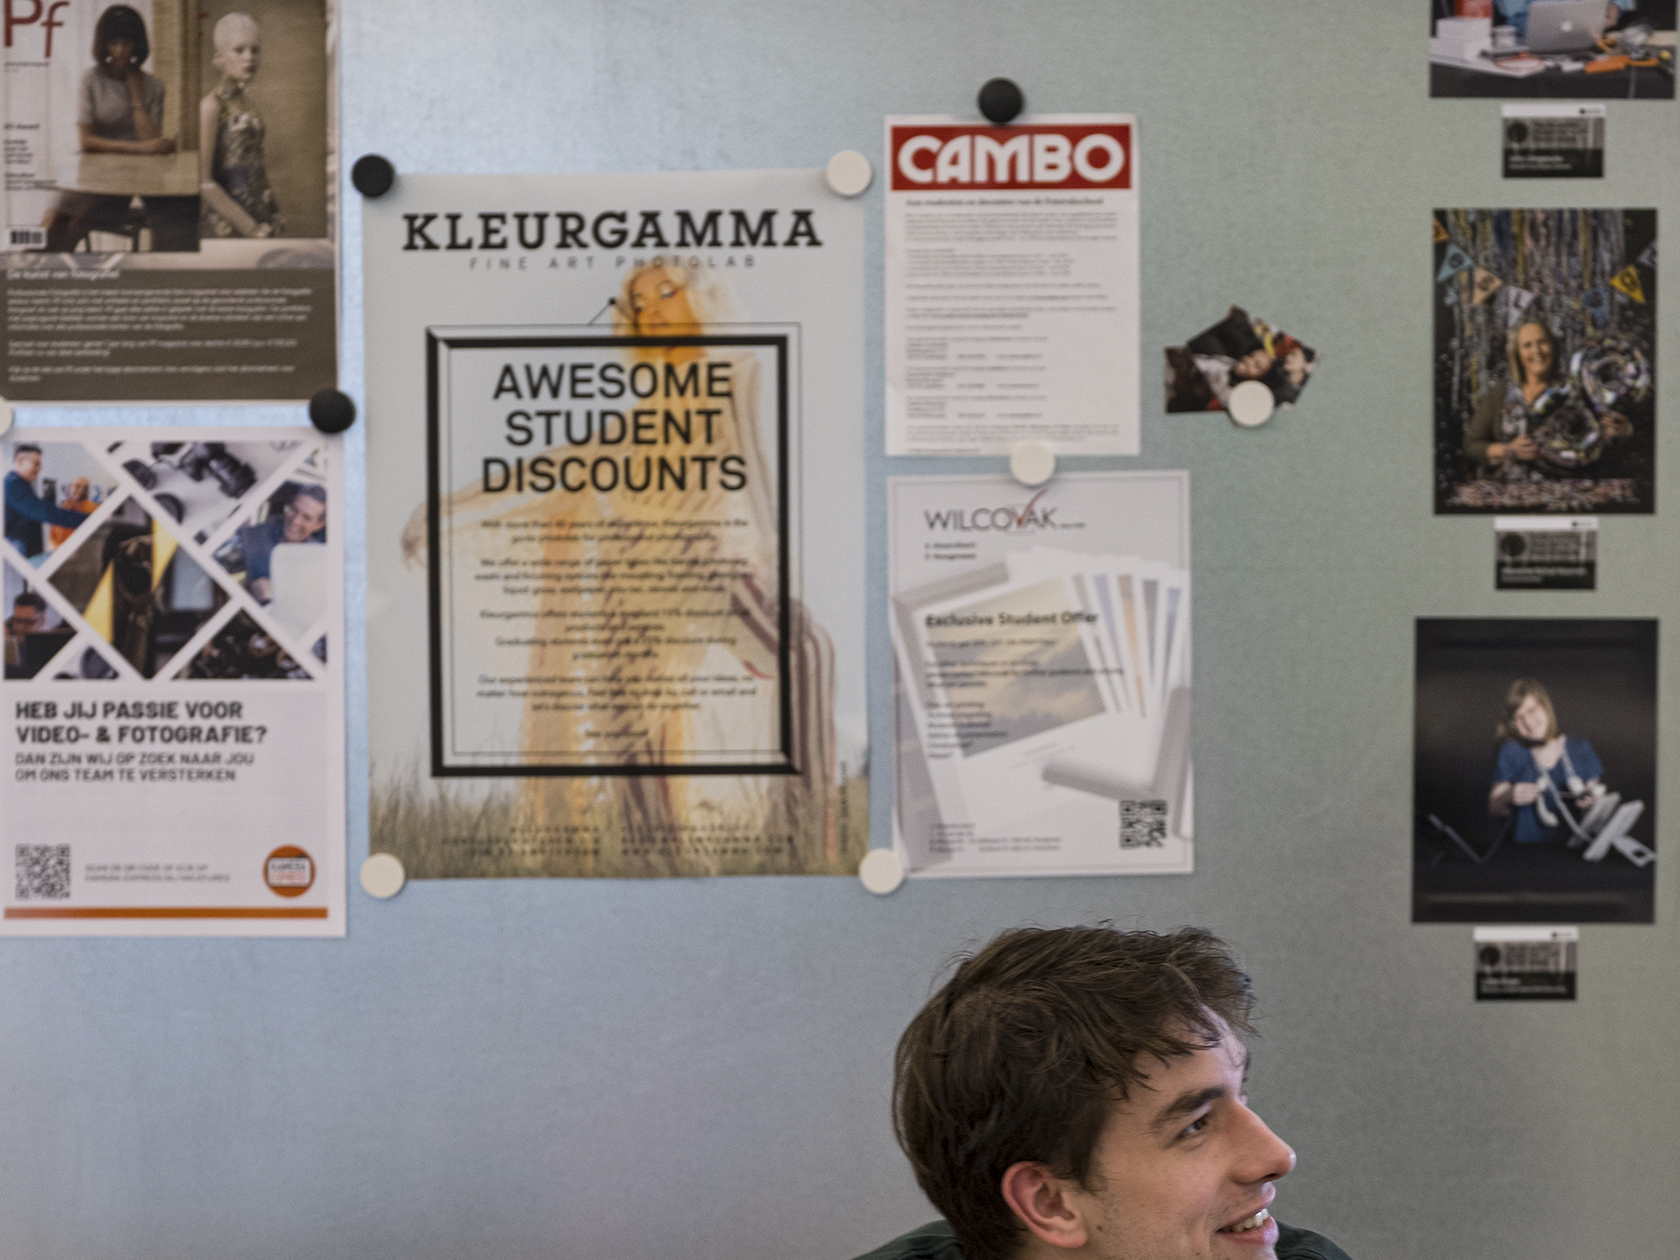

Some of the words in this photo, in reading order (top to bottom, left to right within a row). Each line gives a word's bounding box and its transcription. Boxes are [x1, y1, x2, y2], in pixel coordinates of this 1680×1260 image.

[898, 132, 1126, 184] CAMBO
[402, 209, 823, 251] KLEURGAMMA
[469, 257, 528, 271] FINE
[548, 255, 596, 270] ART
[615, 254, 756, 270] PHOTOLAB
[493, 362, 734, 402] AWESOME
[505, 409, 724, 447] STUDENT
[482, 455, 748, 493] DISCOUNTS
[925, 613, 994, 627] Exclusive
[999, 612, 1058, 626] Student
[15, 701, 58, 719] HEB
[63, 701, 98, 719] JIJ
[102, 701, 179, 719] PASSIE
[186, 701, 243, 719] VOOR
[17, 725, 90, 743] VIDEO-
[96, 725, 111, 743] &
[117, 725, 268, 744] FOTOGRAFIE?
[75, 768, 115, 782] TEAM
[139, 768, 236, 782] VERSTERKEN
